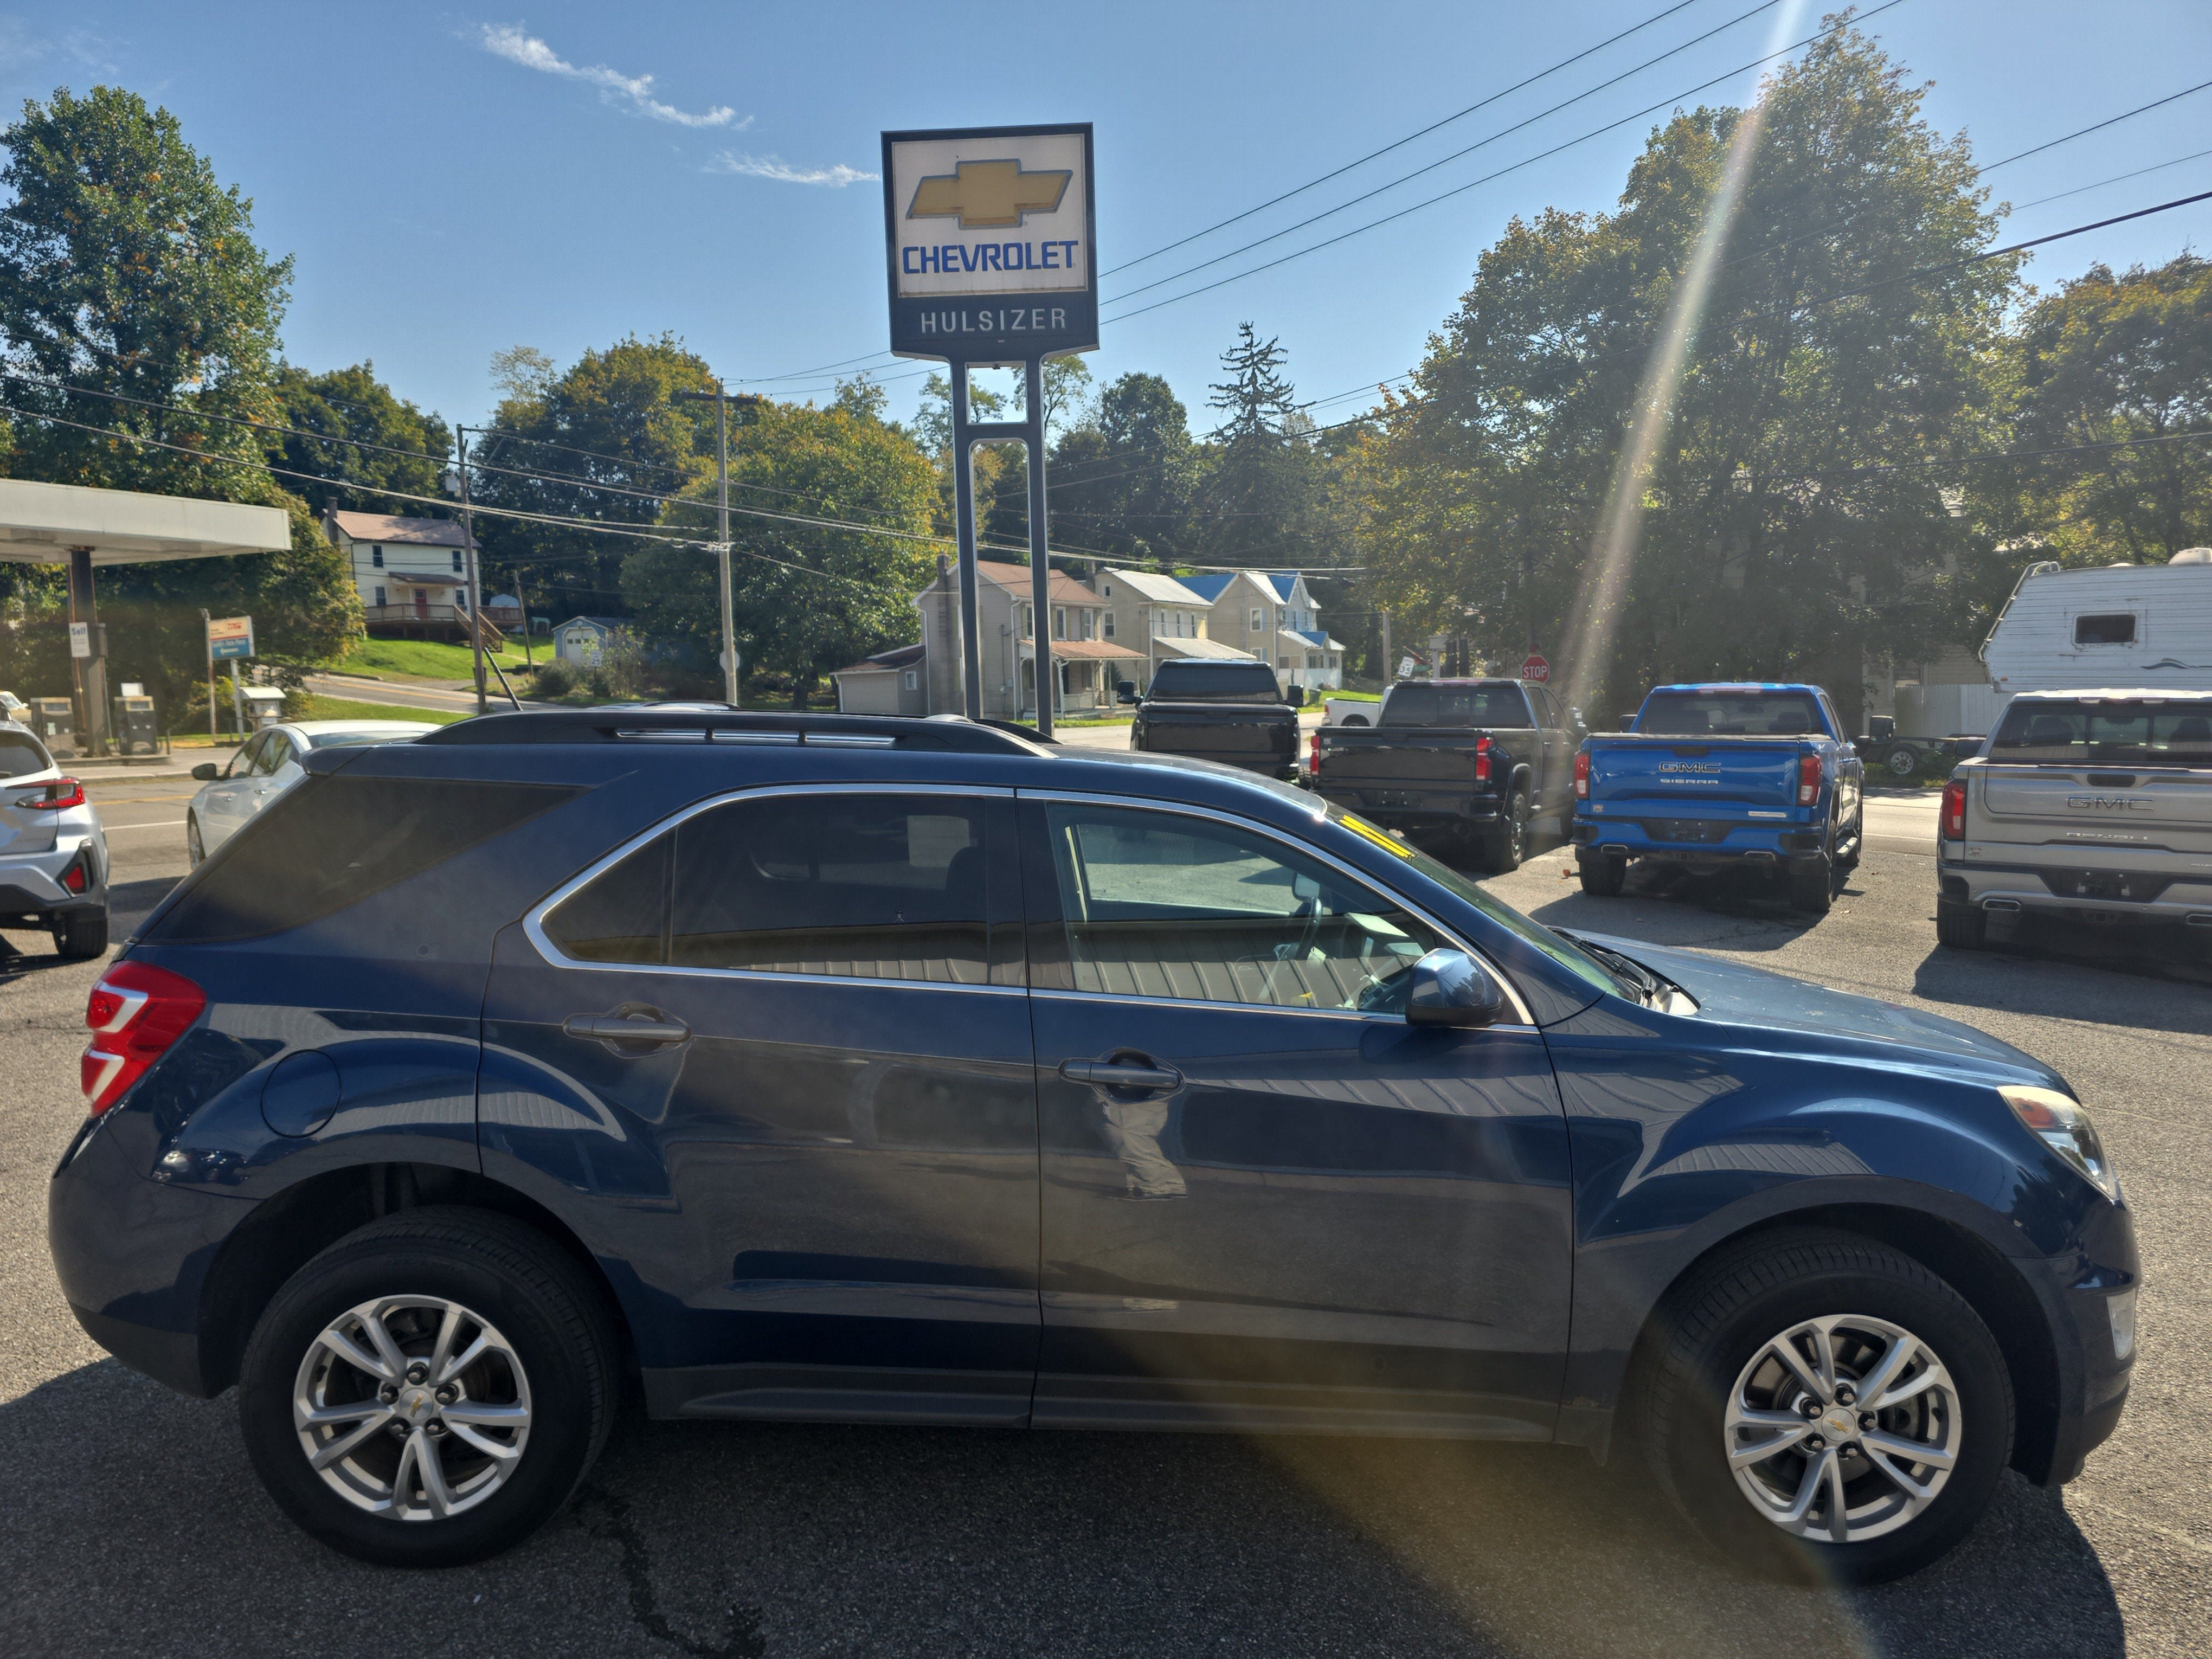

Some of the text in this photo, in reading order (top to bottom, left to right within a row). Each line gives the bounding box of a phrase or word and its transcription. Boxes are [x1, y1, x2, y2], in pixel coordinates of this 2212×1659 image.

[903, 241, 1078, 274] CHEVROLET
[921, 308, 1066, 333] HULSIZER
[1399, 666, 1411, 674] 35
[1523, 666, 1547, 679] STOP
[1659, 761, 1721, 773] GMC
[2066, 796, 2154, 813] GMC
